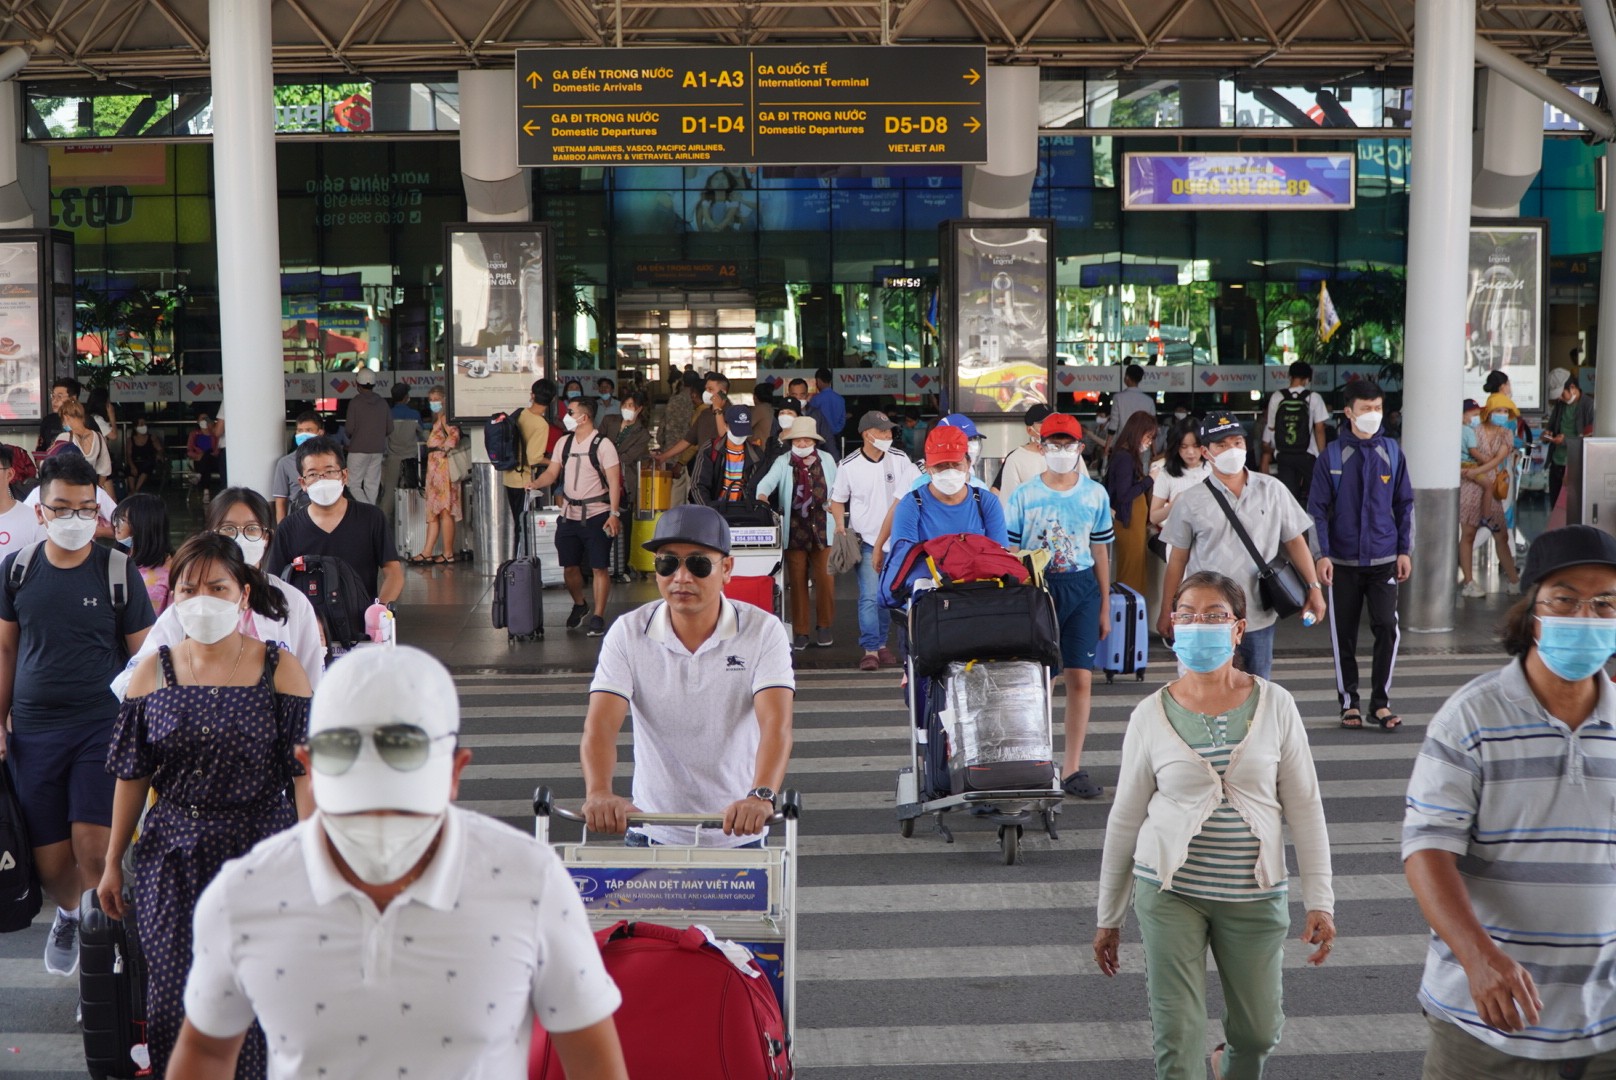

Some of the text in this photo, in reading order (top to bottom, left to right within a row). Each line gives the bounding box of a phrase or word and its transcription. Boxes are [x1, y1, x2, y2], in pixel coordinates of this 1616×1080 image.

[553, 66, 674, 80] GA ĐẾN TRONG NƯỚC
[758, 61, 828, 75] GA QUỐC TẾ
[682, 70, 745, 88] A1-A3
[758, 77, 869, 88] International Terminal
[553, 82, 643, 92] Domestic Arrivals
[551, 111, 660, 123] GA ĐI TRONG NƯỚC
[758, 109, 867, 121] GA ĐI TRONG NƯỚC
[682, 116, 745, 134] D1-D4
[759, 125, 865, 136] Domestic Departures
[885, 116, 948, 134] D5-D8
[551, 127, 657, 138] Domestic Departures
[553, 144, 726, 153] VIETNAM AIRLINES, VASCO, PACIFIC AIRLINES,
[888, 144, 945, 153] VIETJET AIR
[553, 152, 710, 161] BAMBOO AIRWAYS & VIETRAVEL AIRLINES
[719, 265, 736, 276] A2
[604, 878, 756, 891] TẬP ĐOÀN DỆT MAY VIỆT NAM
[604, 892, 632, 900] VIETNAM
[632, 892, 663, 900] NATIONAL
[664, 892, 687, 900] TEXTILE
[688, 892, 702, 900] AND
[733, 892, 756, 900] GROUP
